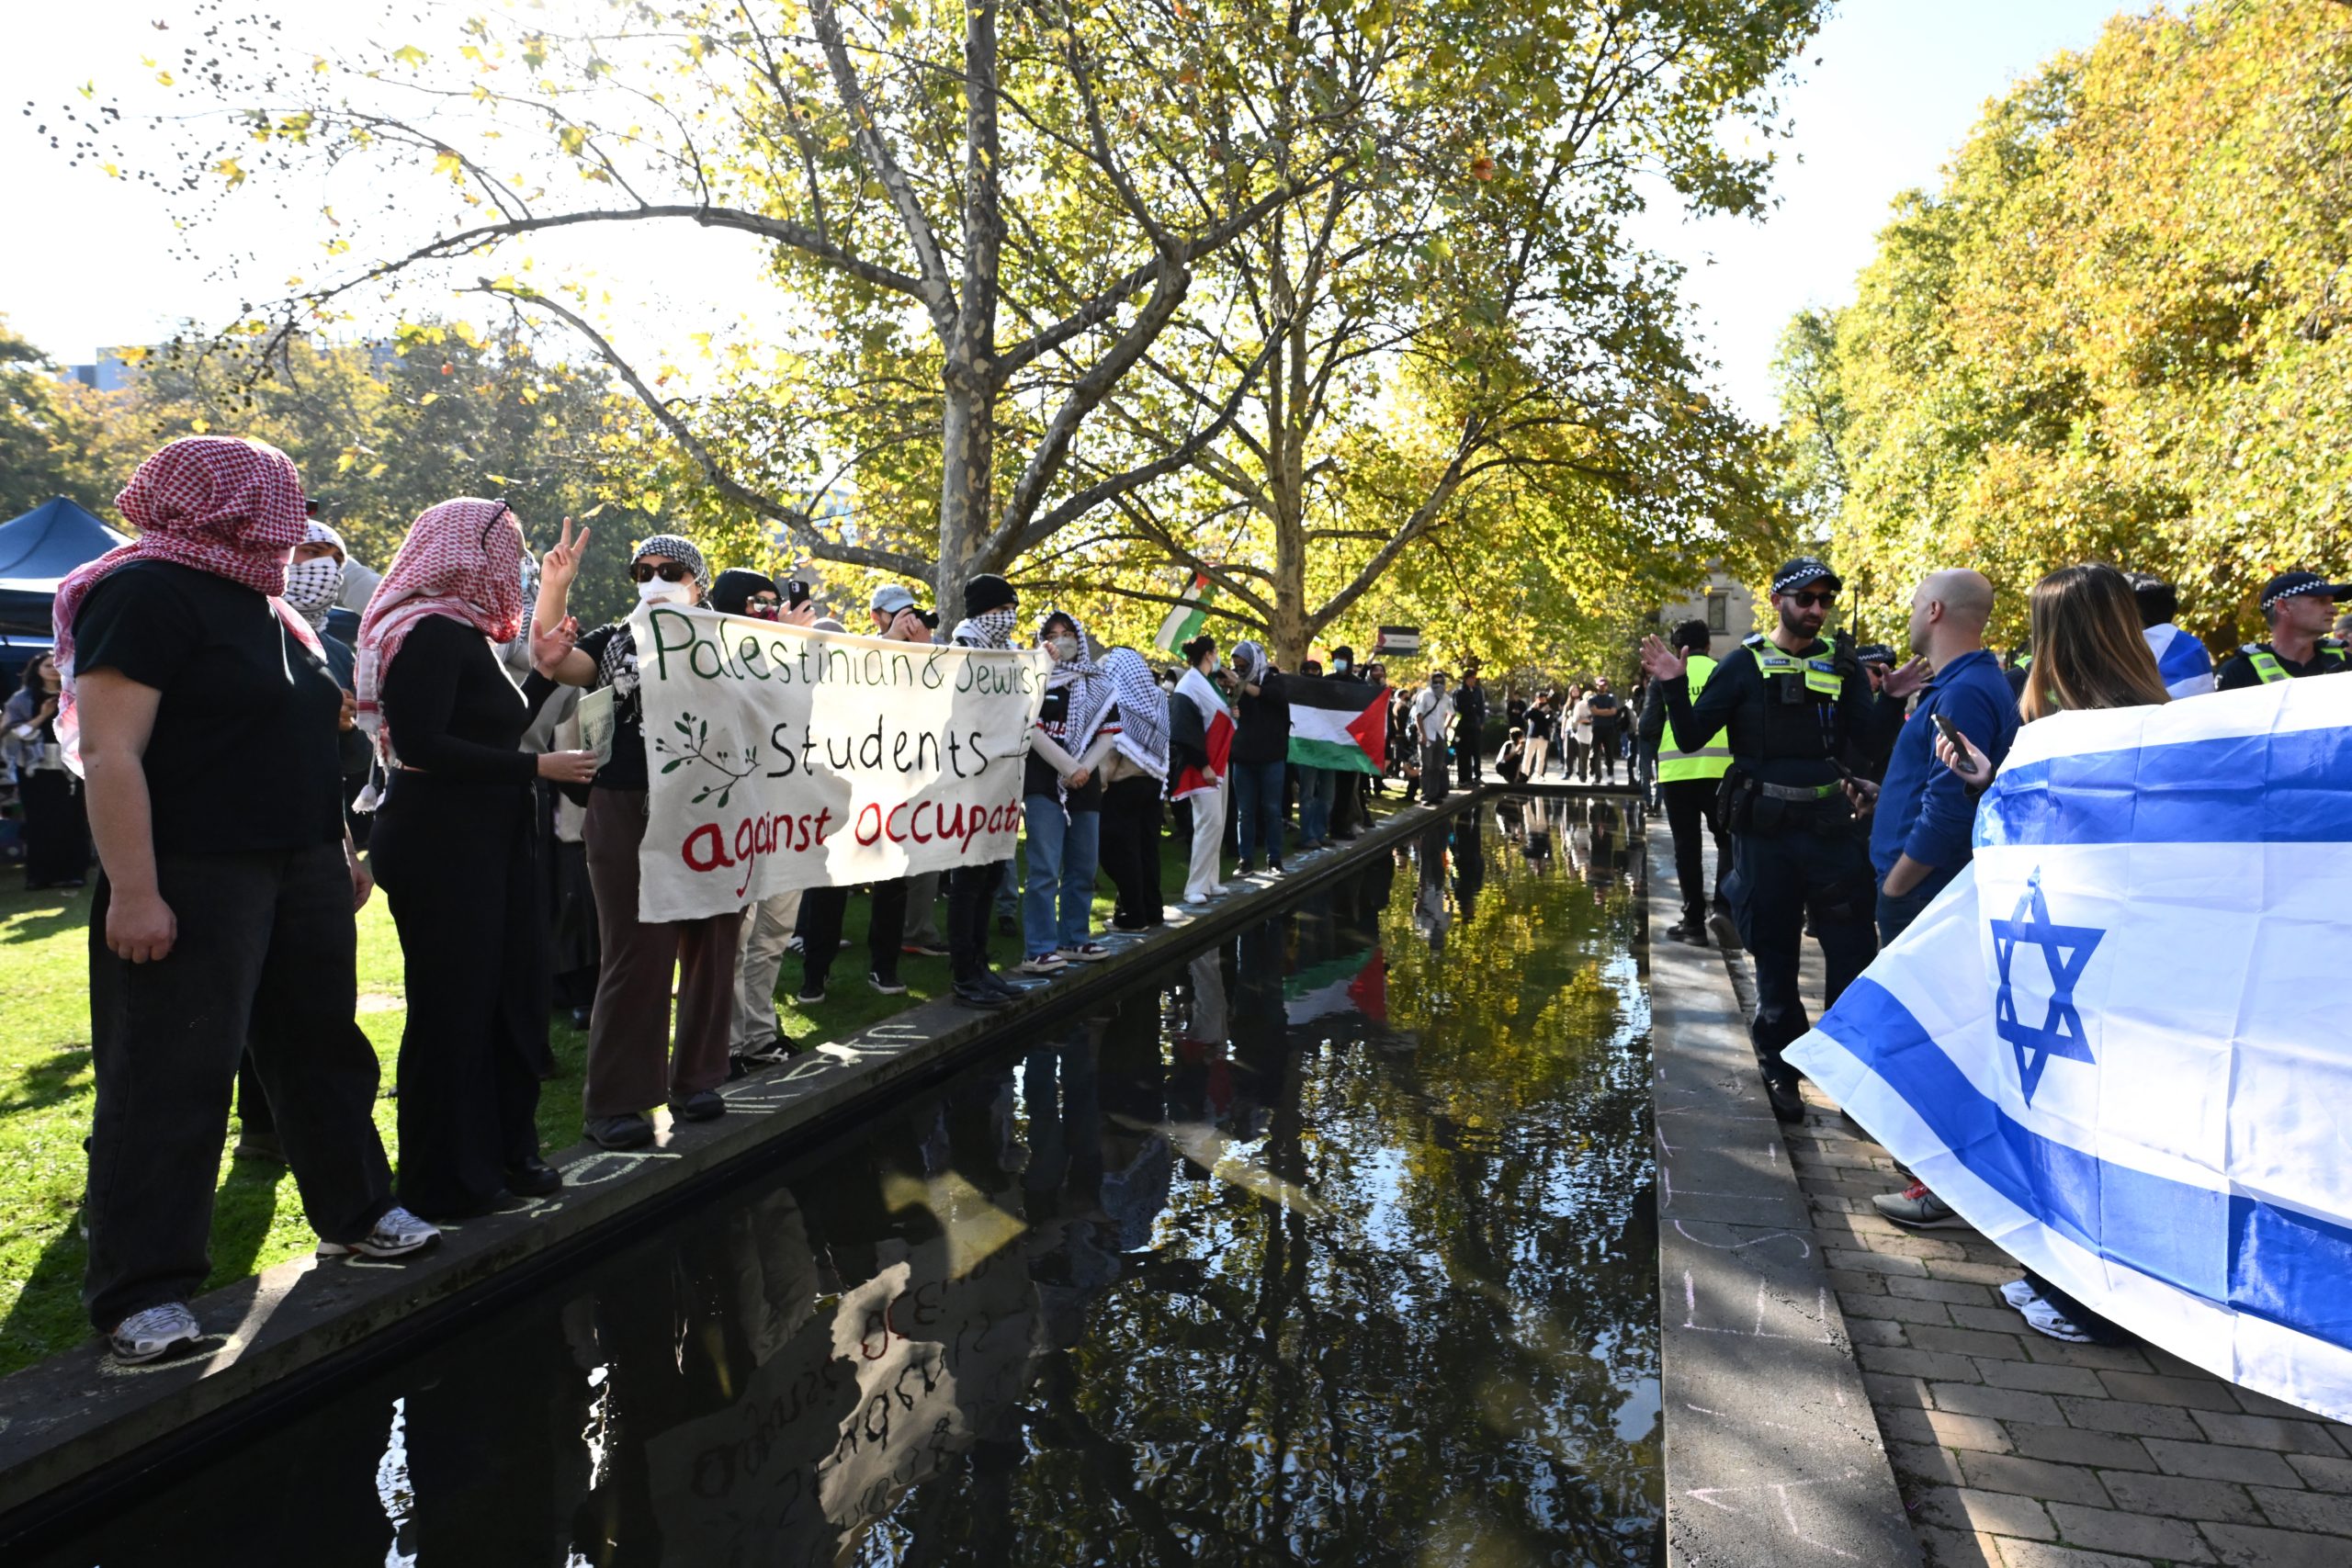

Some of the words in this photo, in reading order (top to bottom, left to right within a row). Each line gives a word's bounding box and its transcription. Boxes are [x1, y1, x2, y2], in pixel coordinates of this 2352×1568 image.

[650, 609, 912, 686] Palestinian
[922, 646, 950, 689] &
[956, 650, 1046, 695] Jewish
[682, 807, 831, 897] against
